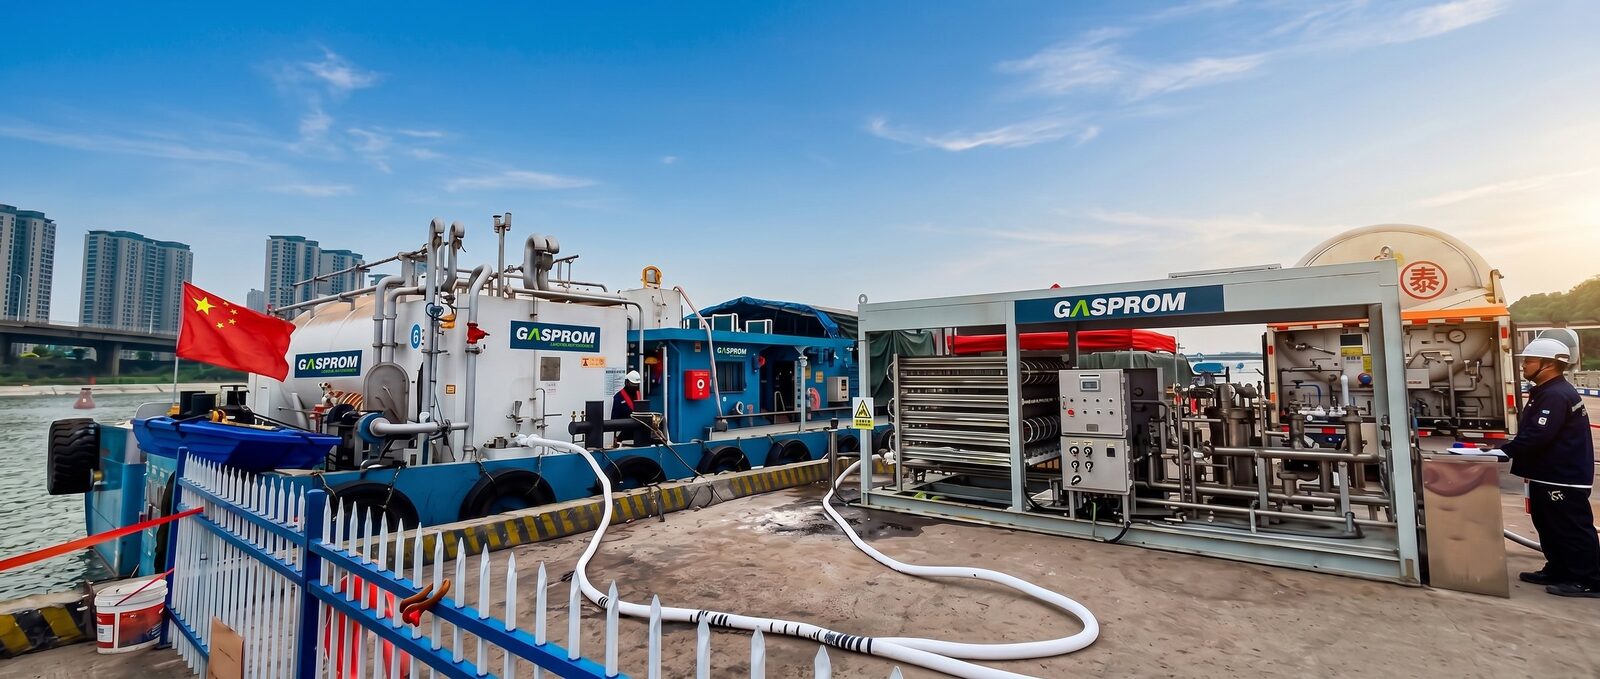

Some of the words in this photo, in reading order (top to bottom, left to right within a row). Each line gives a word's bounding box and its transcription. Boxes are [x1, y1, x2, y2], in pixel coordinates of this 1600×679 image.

[1409, 266, 1440, 293] 泰
[1053, 292, 1186, 318] GASPROM
[413, 329, 419, 344] 6
[516, 327, 596, 344] GASPROM
[716, 347, 747, 355] GASPROM
[298, 355, 359, 371] GASPROM
